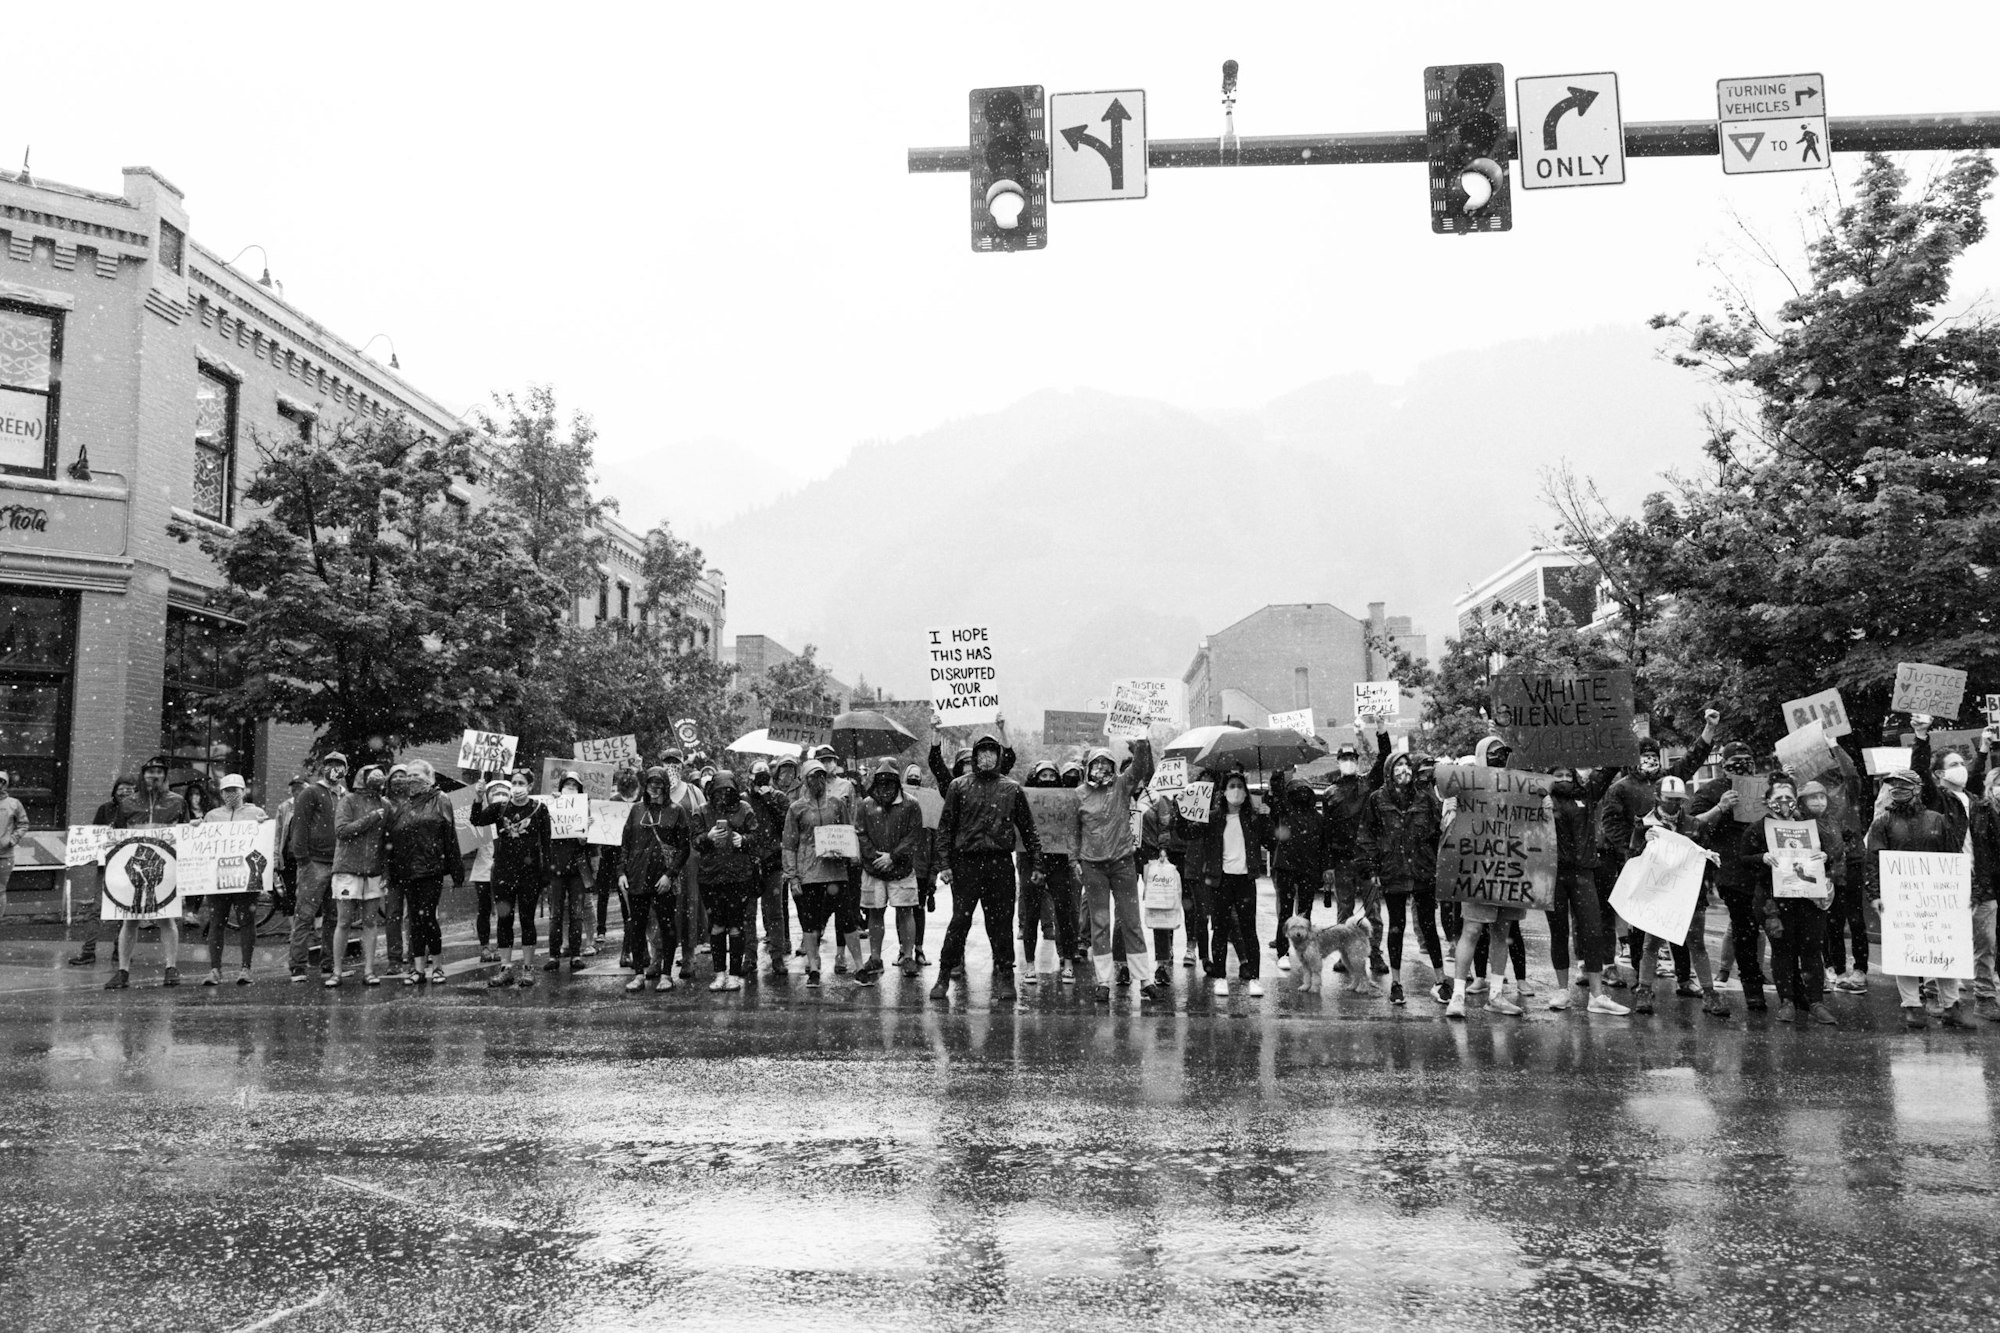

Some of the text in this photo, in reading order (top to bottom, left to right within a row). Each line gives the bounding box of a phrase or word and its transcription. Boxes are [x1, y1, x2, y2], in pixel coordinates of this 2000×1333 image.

[1726, 83, 1786, 97] TURNING
[1725, 100, 1790, 115] VEHICLES
[1771, 140, 1788, 151] TO
[1536, 154, 1609, 179] ONLY
[928, 627, 988, 644] I HOPE
[930, 646, 992, 661] THIS HAS
[930, 666, 995, 681] DISRUPTED
[1904, 667, 1963, 689] JUSTICE
[949, 682, 981, 695] YOUR
[1356, 685, 1388, 696] Liberty
[1521, 677, 1612, 705] WHITE
[1915, 685, 1942, 698] FOR
[936, 694, 999, 711] VACATION
[1358, 705, 1377, 714] FOR
[1897, 696, 1953, 715] GEORGE
[771, 711, 832, 729] BLACK LIVES
[1494, 702, 1591, 728] SILENCE
[582, 737, 630, 753] BLACK
[1513, 727, 1625, 753] VIOLENCE
[473, 744, 500, 758] LIVES
[584, 749, 631, 761] LIVES
[1446, 770, 1548, 796] ALL LIVES
[1497, 804, 1548, 823] MATTER
[182, 822, 260, 840] BLACK LIVES
[554, 825, 572, 835] UP
[1471, 819, 1520, 839] UNTIL
[1459, 859, 1524, 878] LIVES
[1939, 856, 1963, 876] WE
[1452, 877, 1535, 902] MATTER
[1915, 892, 1961, 909] JUSTICE
